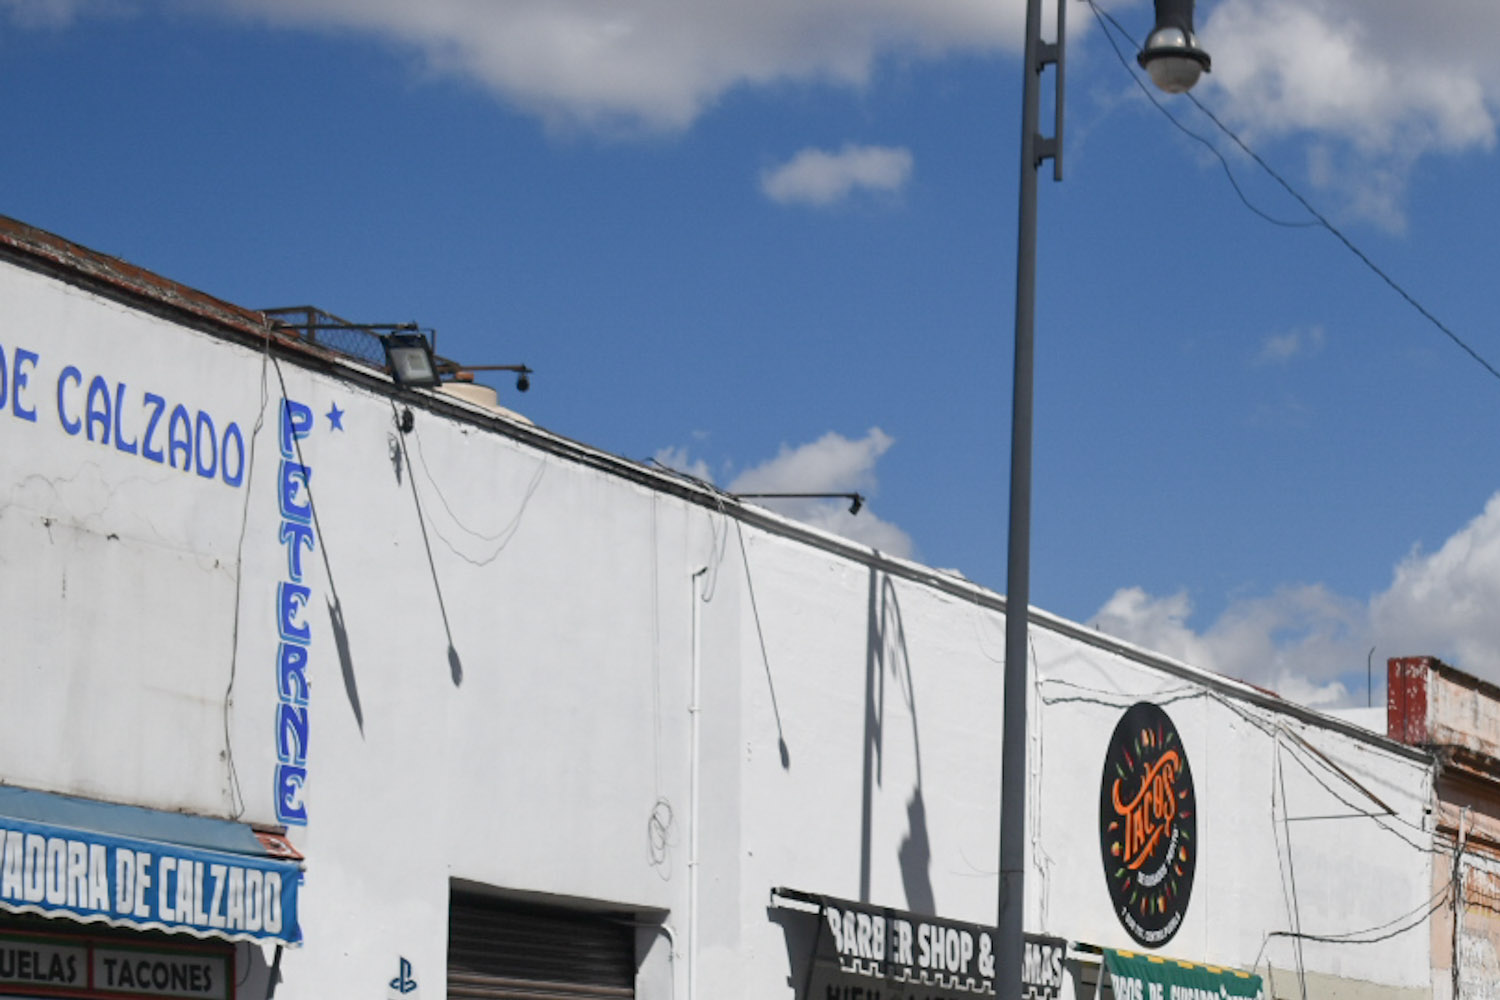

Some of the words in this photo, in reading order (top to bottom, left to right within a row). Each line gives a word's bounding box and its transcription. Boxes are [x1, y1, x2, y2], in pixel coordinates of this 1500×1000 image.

[0, 345, 38, 423] E
[57, 365, 245, 487] CALZADO
[274, 397, 313, 826] PETERNE
[1112, 750, 1182, 869] TACOS
[116, 848, 151, 917] DE
[158, 856, 282, 933] CALZADO
[0, 948, 77, 984] UELAS
[104, 958, 212, 992] TACONES
[918, 923, 973, 974] SHOP
[978, 932, 995, 979] &
